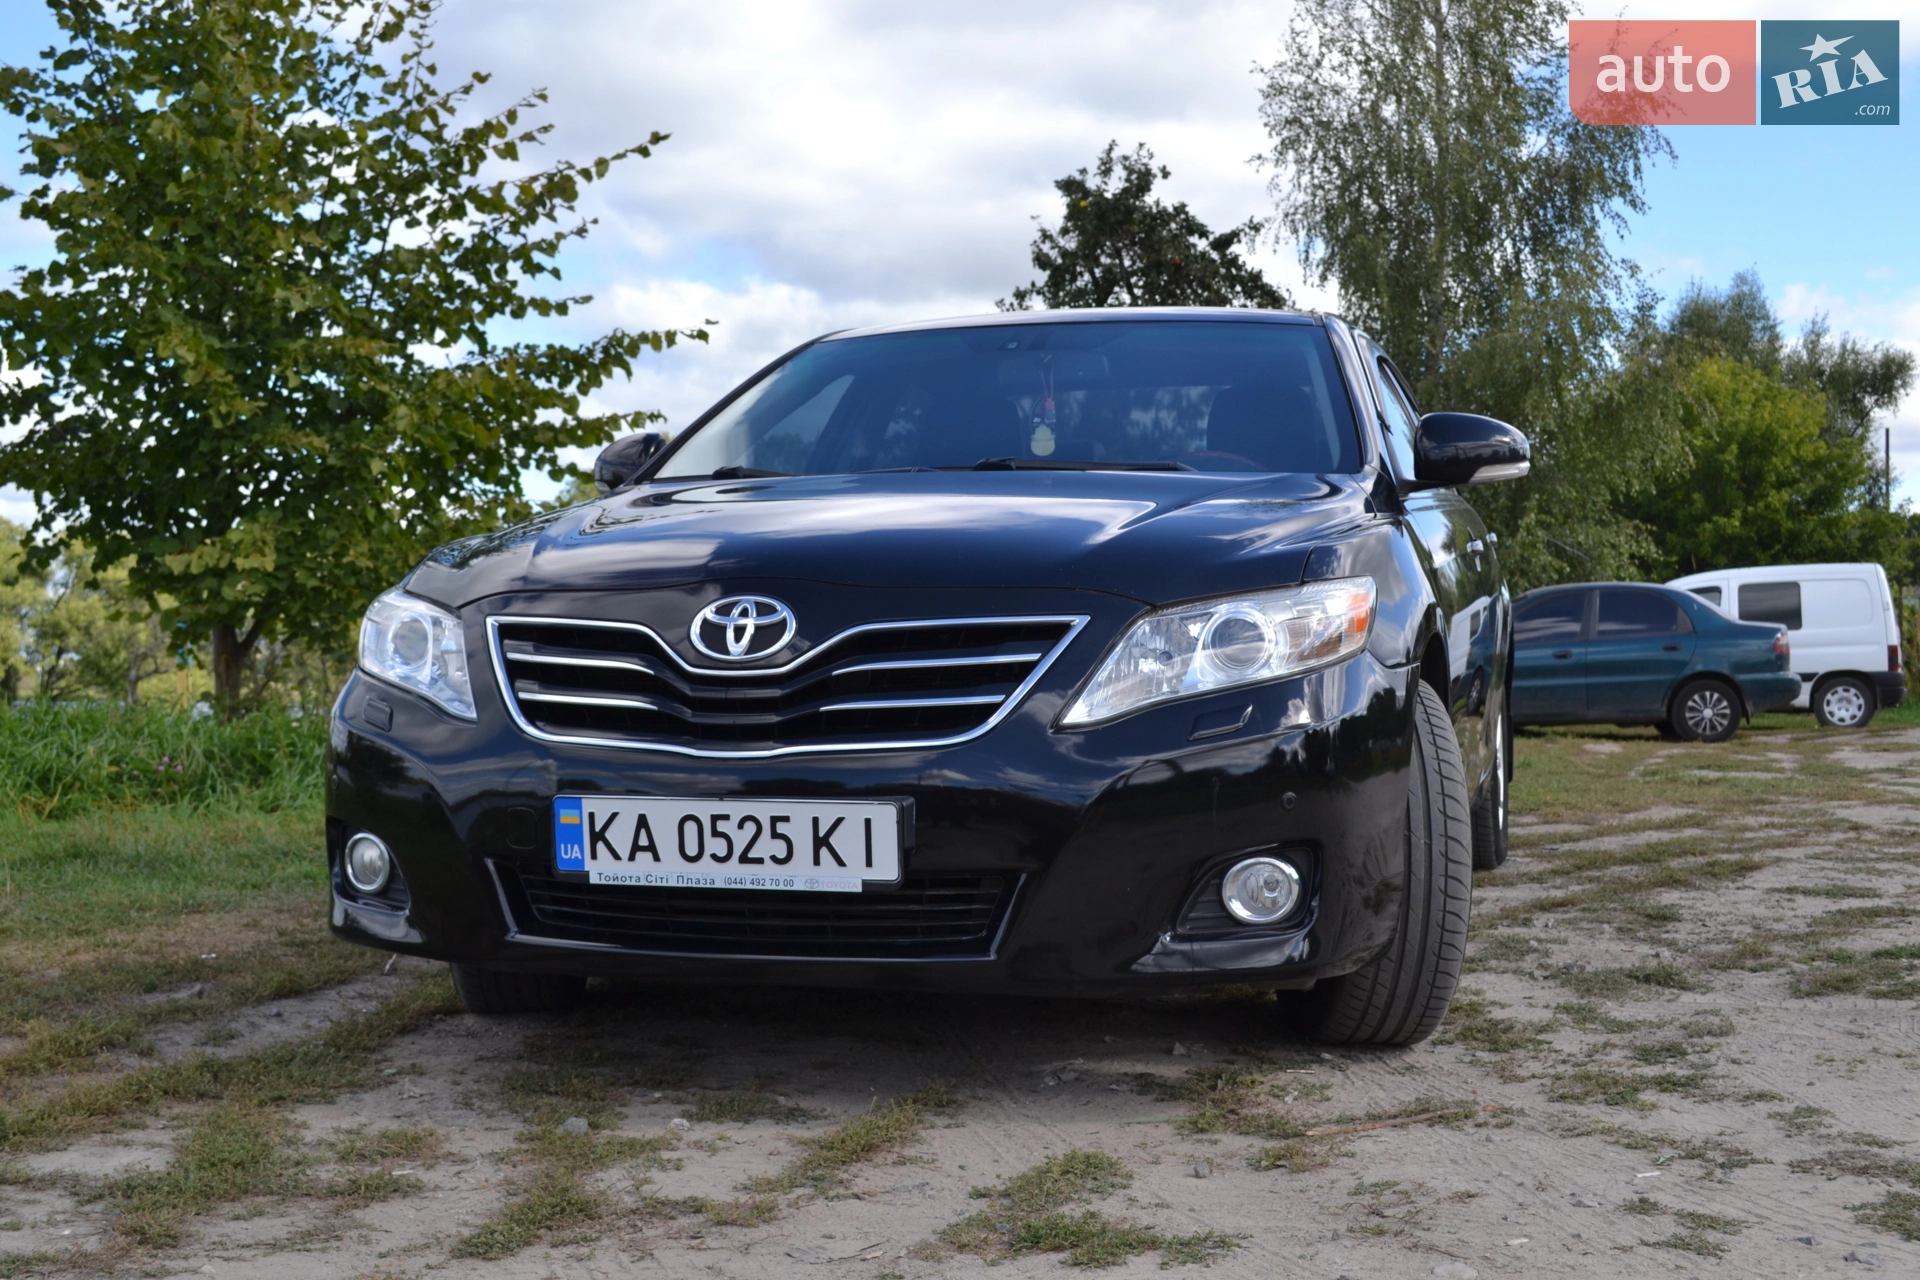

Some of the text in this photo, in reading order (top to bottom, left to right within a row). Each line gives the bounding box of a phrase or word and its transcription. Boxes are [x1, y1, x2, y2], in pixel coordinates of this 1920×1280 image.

[588, 811, 662, 862] KA
[677, 813, 794, 865] 0525
[560, 843, 582, 860] UA
[597, 872, 794, 888] Тойота Сіті Плаза (044) 492 70 00
[820, 880, 859, 890] TOYOTA
